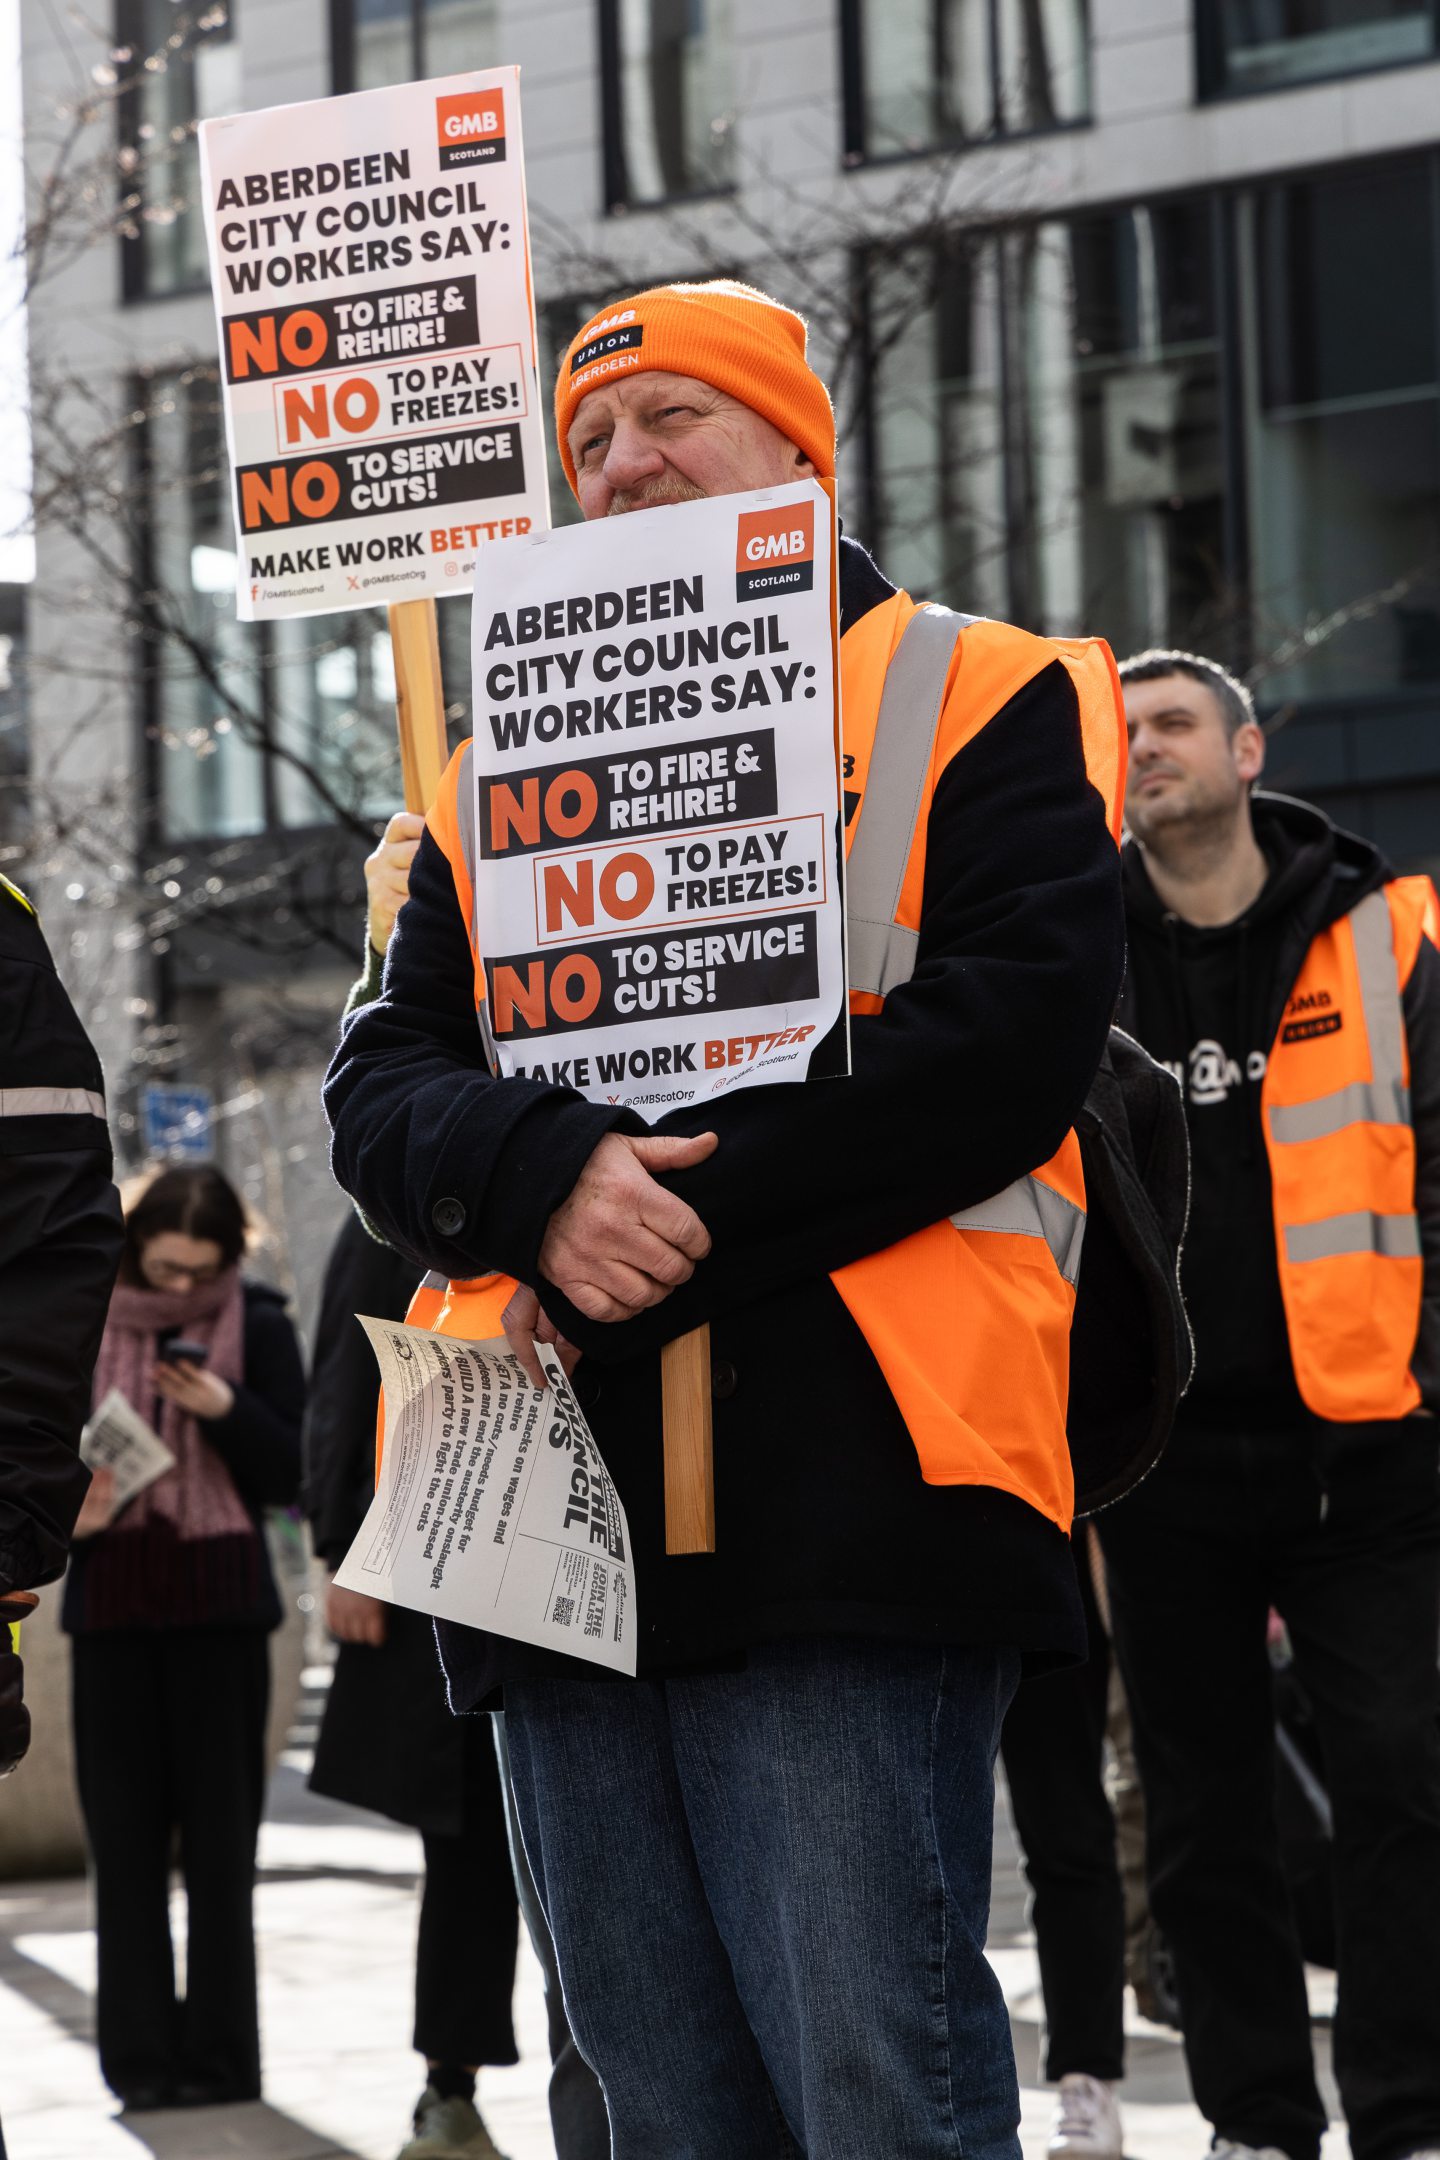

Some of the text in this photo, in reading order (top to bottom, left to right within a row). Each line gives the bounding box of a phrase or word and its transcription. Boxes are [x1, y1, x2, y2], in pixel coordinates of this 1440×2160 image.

[444, 111, 498, 137] GMB
[449, 147, 496, 161] SCOTLAND
[216, 149, 411, 212] ABERDEEN
[221, 182, 486, 253] CITY COUNCIL
[225, 220, 511, 295] WORKERS SAY:
[334, 286, 466, 330] TO FIRE &
[582, 309, 637, 343] GMB
[228, 309, 329, 379] NO
[336, 315, 447, 360] REHIRE!
[577, 333, 631, 364] UNION
[388, 358, 491, 396] TO PAY
[570, 353, 639, 392] ABERDEEN
[282, 377, 380, 444] NO
[391, 382, 520, 426] FREEZES!
[347, 433, 512, 481] TO SERVICE
[241, 461, 341, 528] NO
[350, 473, 438, 511] CUTS!
[250, 517, 532, 578] MAKE WORK BETTER
[745, 530, 806, 561] GMB
[362, 569, 426, 589] @GMBScotOrg
[748, 573, 801, 589] SCOTLAND
[483, 575, 704, 652] ABERDEEN
[485, 614, 789, 702] CITY COUNCIL
[489, 661, 817, 752] WORKERS SAY:
[607, 743, 763, 794] TO FIRE &
[489, 769, 599, 851] NO
[609, 780, 737, 831] REHIRE!
[665, 830, 788, 876] TO PAY
[543, 852, 655, 933] NO
[667, 860, 818, 912] FREEZES!
[611, 923, 805, 978] TO SERVICE
[493, 953, 602, 1034] NO
[613, 970, 717, 1014] CUTS!
[594, 1043, 697, 1086] WORK
[704, 1024, 817, 1070] BETTER
[623, 1089, 695, 1107] @GMBScotOrg
[442, 1384, 456, 1420] party
[480, 1393, 491, 1418] and
[498, 1393, 508, 1410] no
[499, 1381, 511, 1390] A
[443, 1424, 455, 1438] to
[475, 1420, 487, 1443] end
[510, 1392, 525, 1432] rehire
[518, 1405, 538, 1454] attacks
[423, 1356, 475, 1559] BUILD A new trade union-based
[434, 1441, 451, 1474] fight
[468, 1446, 481, 1467] the
[512, 1457, 525, 1474] on
[545, 1363, 590, 1529] COUNCIL
[426, 1477, 441, 1499] the
[449, 1469, 473, 1525] austerity
[463, 1488, 484, 1532] budget
[501, 1476, 520, 1517] wages
[590, 1471, 608, 1549] THE
[417, 1502, 431, 1532] cuts
[493, 1519, 508, 1545] and
[430, 1527, 455, 1590] onslaught
[458, 1534, 471, 1553] for
[584, 1562, 600, 1636] SOCIALISTS
[591, 1565, 607, 1638] JOIN THE
